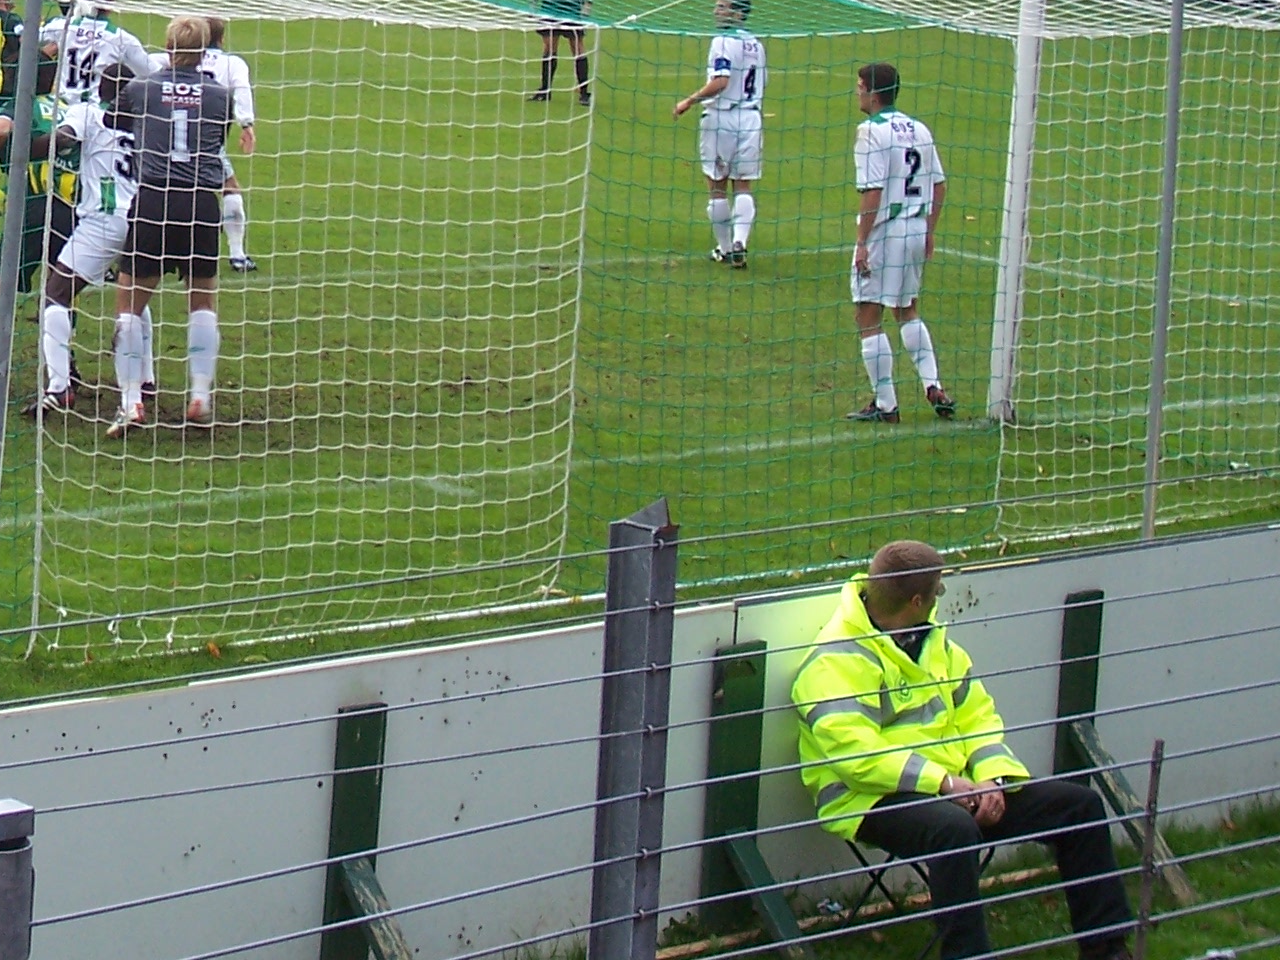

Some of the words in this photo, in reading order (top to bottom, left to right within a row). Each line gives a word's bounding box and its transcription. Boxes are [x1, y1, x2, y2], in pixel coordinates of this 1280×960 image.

[76, 28, 102, 39] BOS
[66, 47, 100, 89] 14
[743, 64, 757, 101] 4
[161, 81, 203, 96] BOS
[171, 109, 191, 162] 1
[891, 122, 915, 133] BOS
[904, 147, 922, 198] 2
